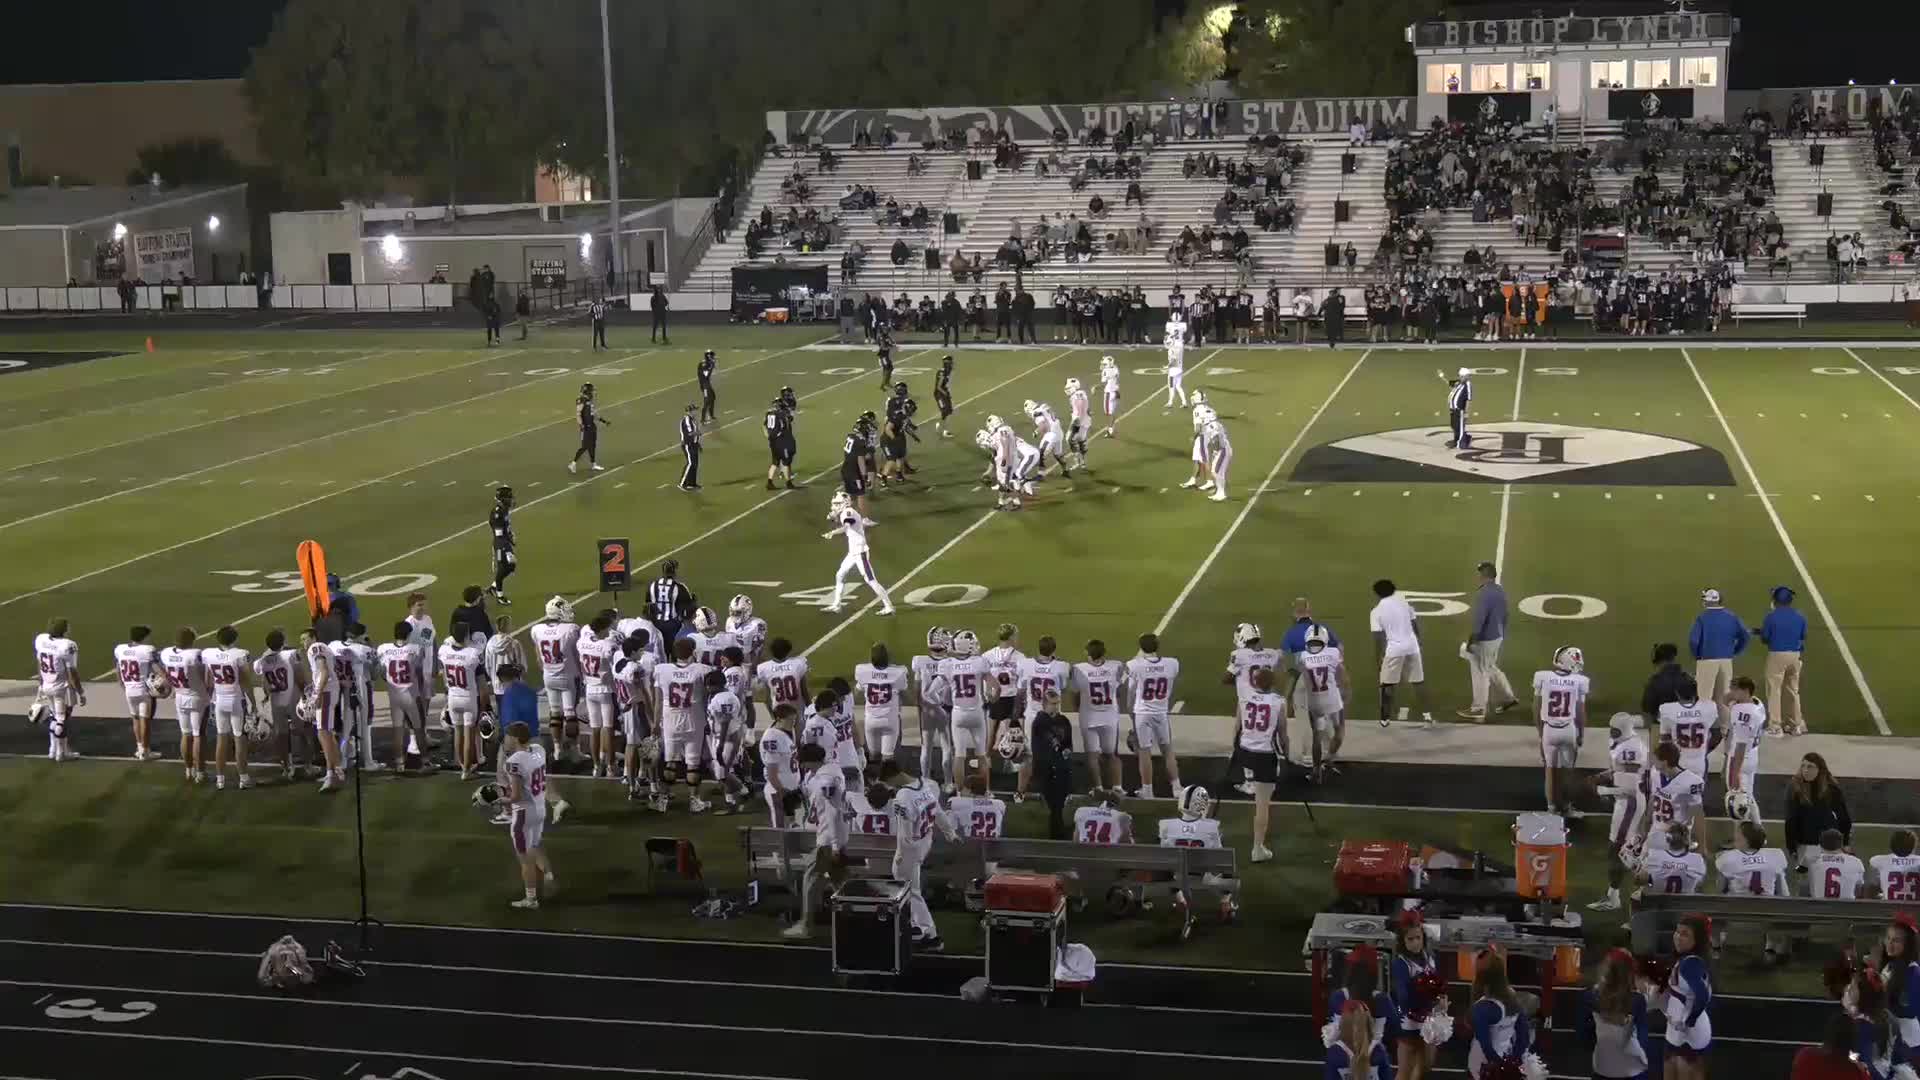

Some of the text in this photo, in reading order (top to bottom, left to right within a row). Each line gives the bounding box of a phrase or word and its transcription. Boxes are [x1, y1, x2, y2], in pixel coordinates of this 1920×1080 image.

[1445, 13, 1710, 46] BISHOP LYNCH
[1242, 98, 1408, 133] STADIUM
[602, 543, 625, 573] 2
[40, 652, 56, 674] 61
[446, 665, 468, 688] 50
[771, 675, 798, 703] 30
[953, 674, 976, 698] 15
[1142, 677, 1169, 701] 60
[1307, 667, 1329, 692] 17
[668, 682, 694, 708] 67
[867, 683, 893, 705] 63
[1089, 680, 1113, 705] 51
[1548, 690, 1572, 718] 21
[1244, 702, 1272, 731] 33
[1738, 711, 1751, 723] 10
[1676, 723, 1705, 749] 56
[1622, 750, 1636, 761] 13
[971, 811, 997, 838] 22
[1084, 819, 1113, 845] 34
[1824, 867, 1842, 898] 6
